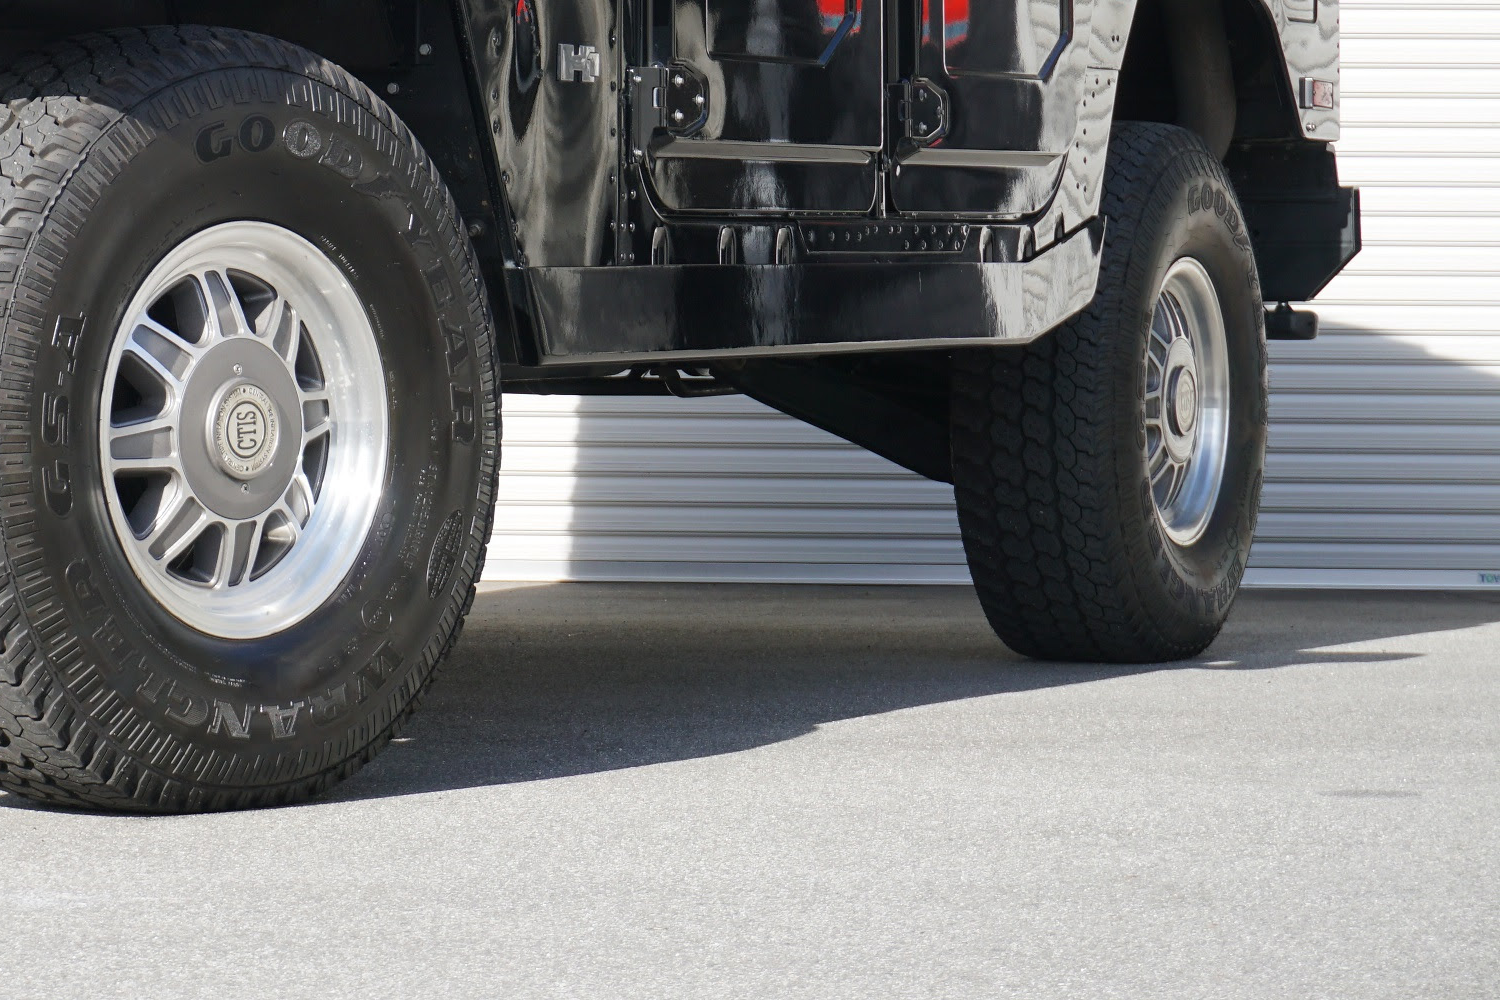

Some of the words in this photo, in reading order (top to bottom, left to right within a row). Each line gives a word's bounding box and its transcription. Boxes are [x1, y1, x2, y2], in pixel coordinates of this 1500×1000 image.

[42, 311, 88, 519] GS-A
[237, 411, 257, 450] CTIS
[65, 557, 405, 740] WRANGLER
